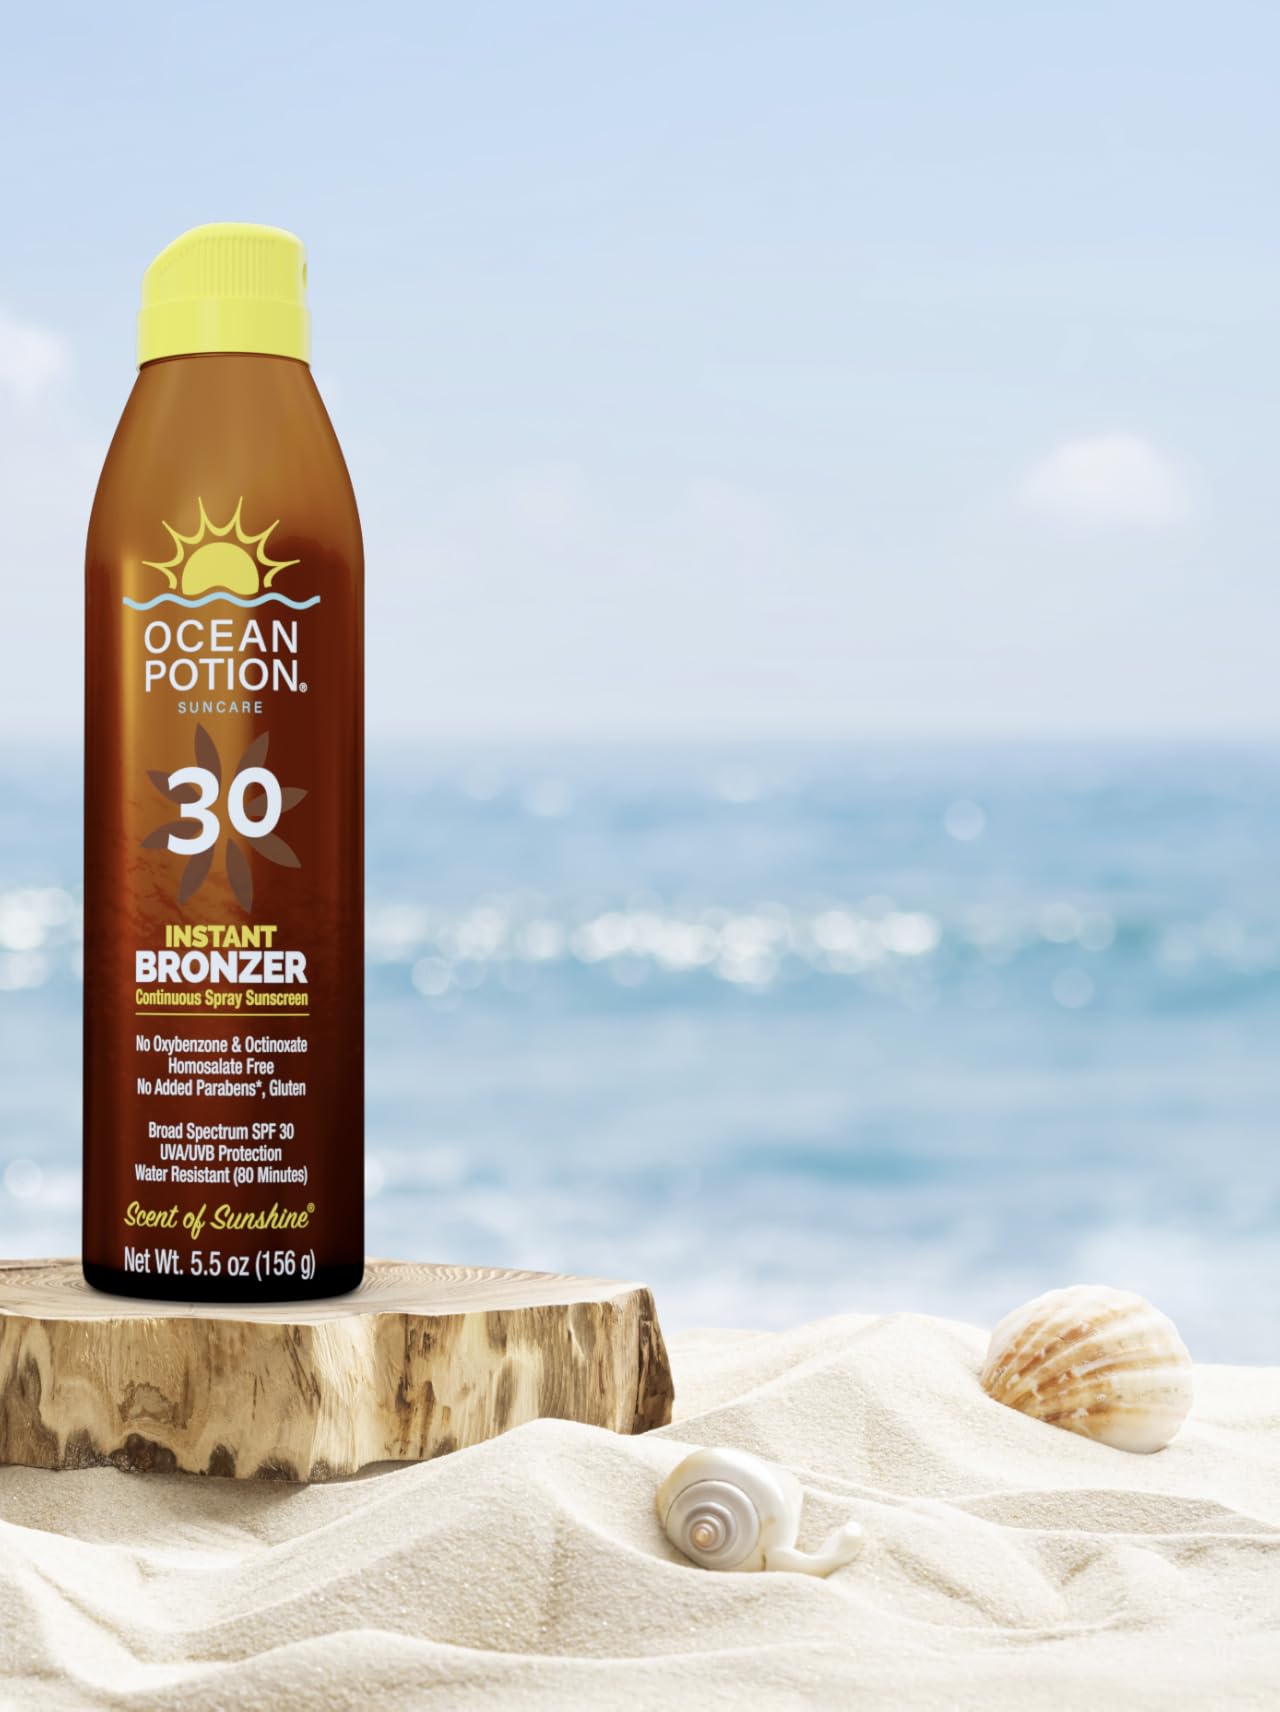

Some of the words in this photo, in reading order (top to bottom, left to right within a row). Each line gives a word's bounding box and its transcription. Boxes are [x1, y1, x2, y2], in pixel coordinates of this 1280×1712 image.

[144, 619, 297, 654] OCEAN
[178, 701, 263, 714] SUNCARE
[167, 766, 282, 855] 30
[165, 925, 277, 948] INSTANT
[136, 950, 308, 983] BRONZER
[136, 989, 202, 1006] Continuous
[205, 990, 243, 1009] Spray
[245, 990, 308, 1006] Sunscreen
[136, 1035, 150, 1052] No
[154, 1035, 227, 1056] Oxybenzone
[232, 1036, 241, 1052] &
[245, 1036, 307, 1053] Octinoxate
[168, 1057, 243, 1074] Homosalate
[247, 1058, 274, 1075] Free
[137, 1078, 152, 1095] No
[155, 1078, 193, 1096] Added
[269, 1079, 306, 1096] Gluten
[149, 1122, 183, 1139] Broad
[187, 1123, 248, 1142] Spectrum
[252, 1123, 276, 1139] SPF
[279, 1123, 294, 1140] 30
[160, 1144, 215, 1161] UVA/UVB
[218, 1146, 282, 1161] Protection
[135, 1164, 168, 1182] Water
[171, 1165, 230, 1184] Resistant
[233, 1167, 254, 1186] (80
[258, 1167, 308, 1185] Minutes)
[124, 1201, 178, 1228] Scent
[183, 1204, 207, 1240] of
[124, 1246, 150, 1273] Net
[155, 1248, 183, 1275] Wt.
[191, 1251, 221, 1276] 5.5
[227, 1255, 249, 1276] oz
[256, 1250, 295, 1281] (156
[301, 1249, 316, 1279] g)
